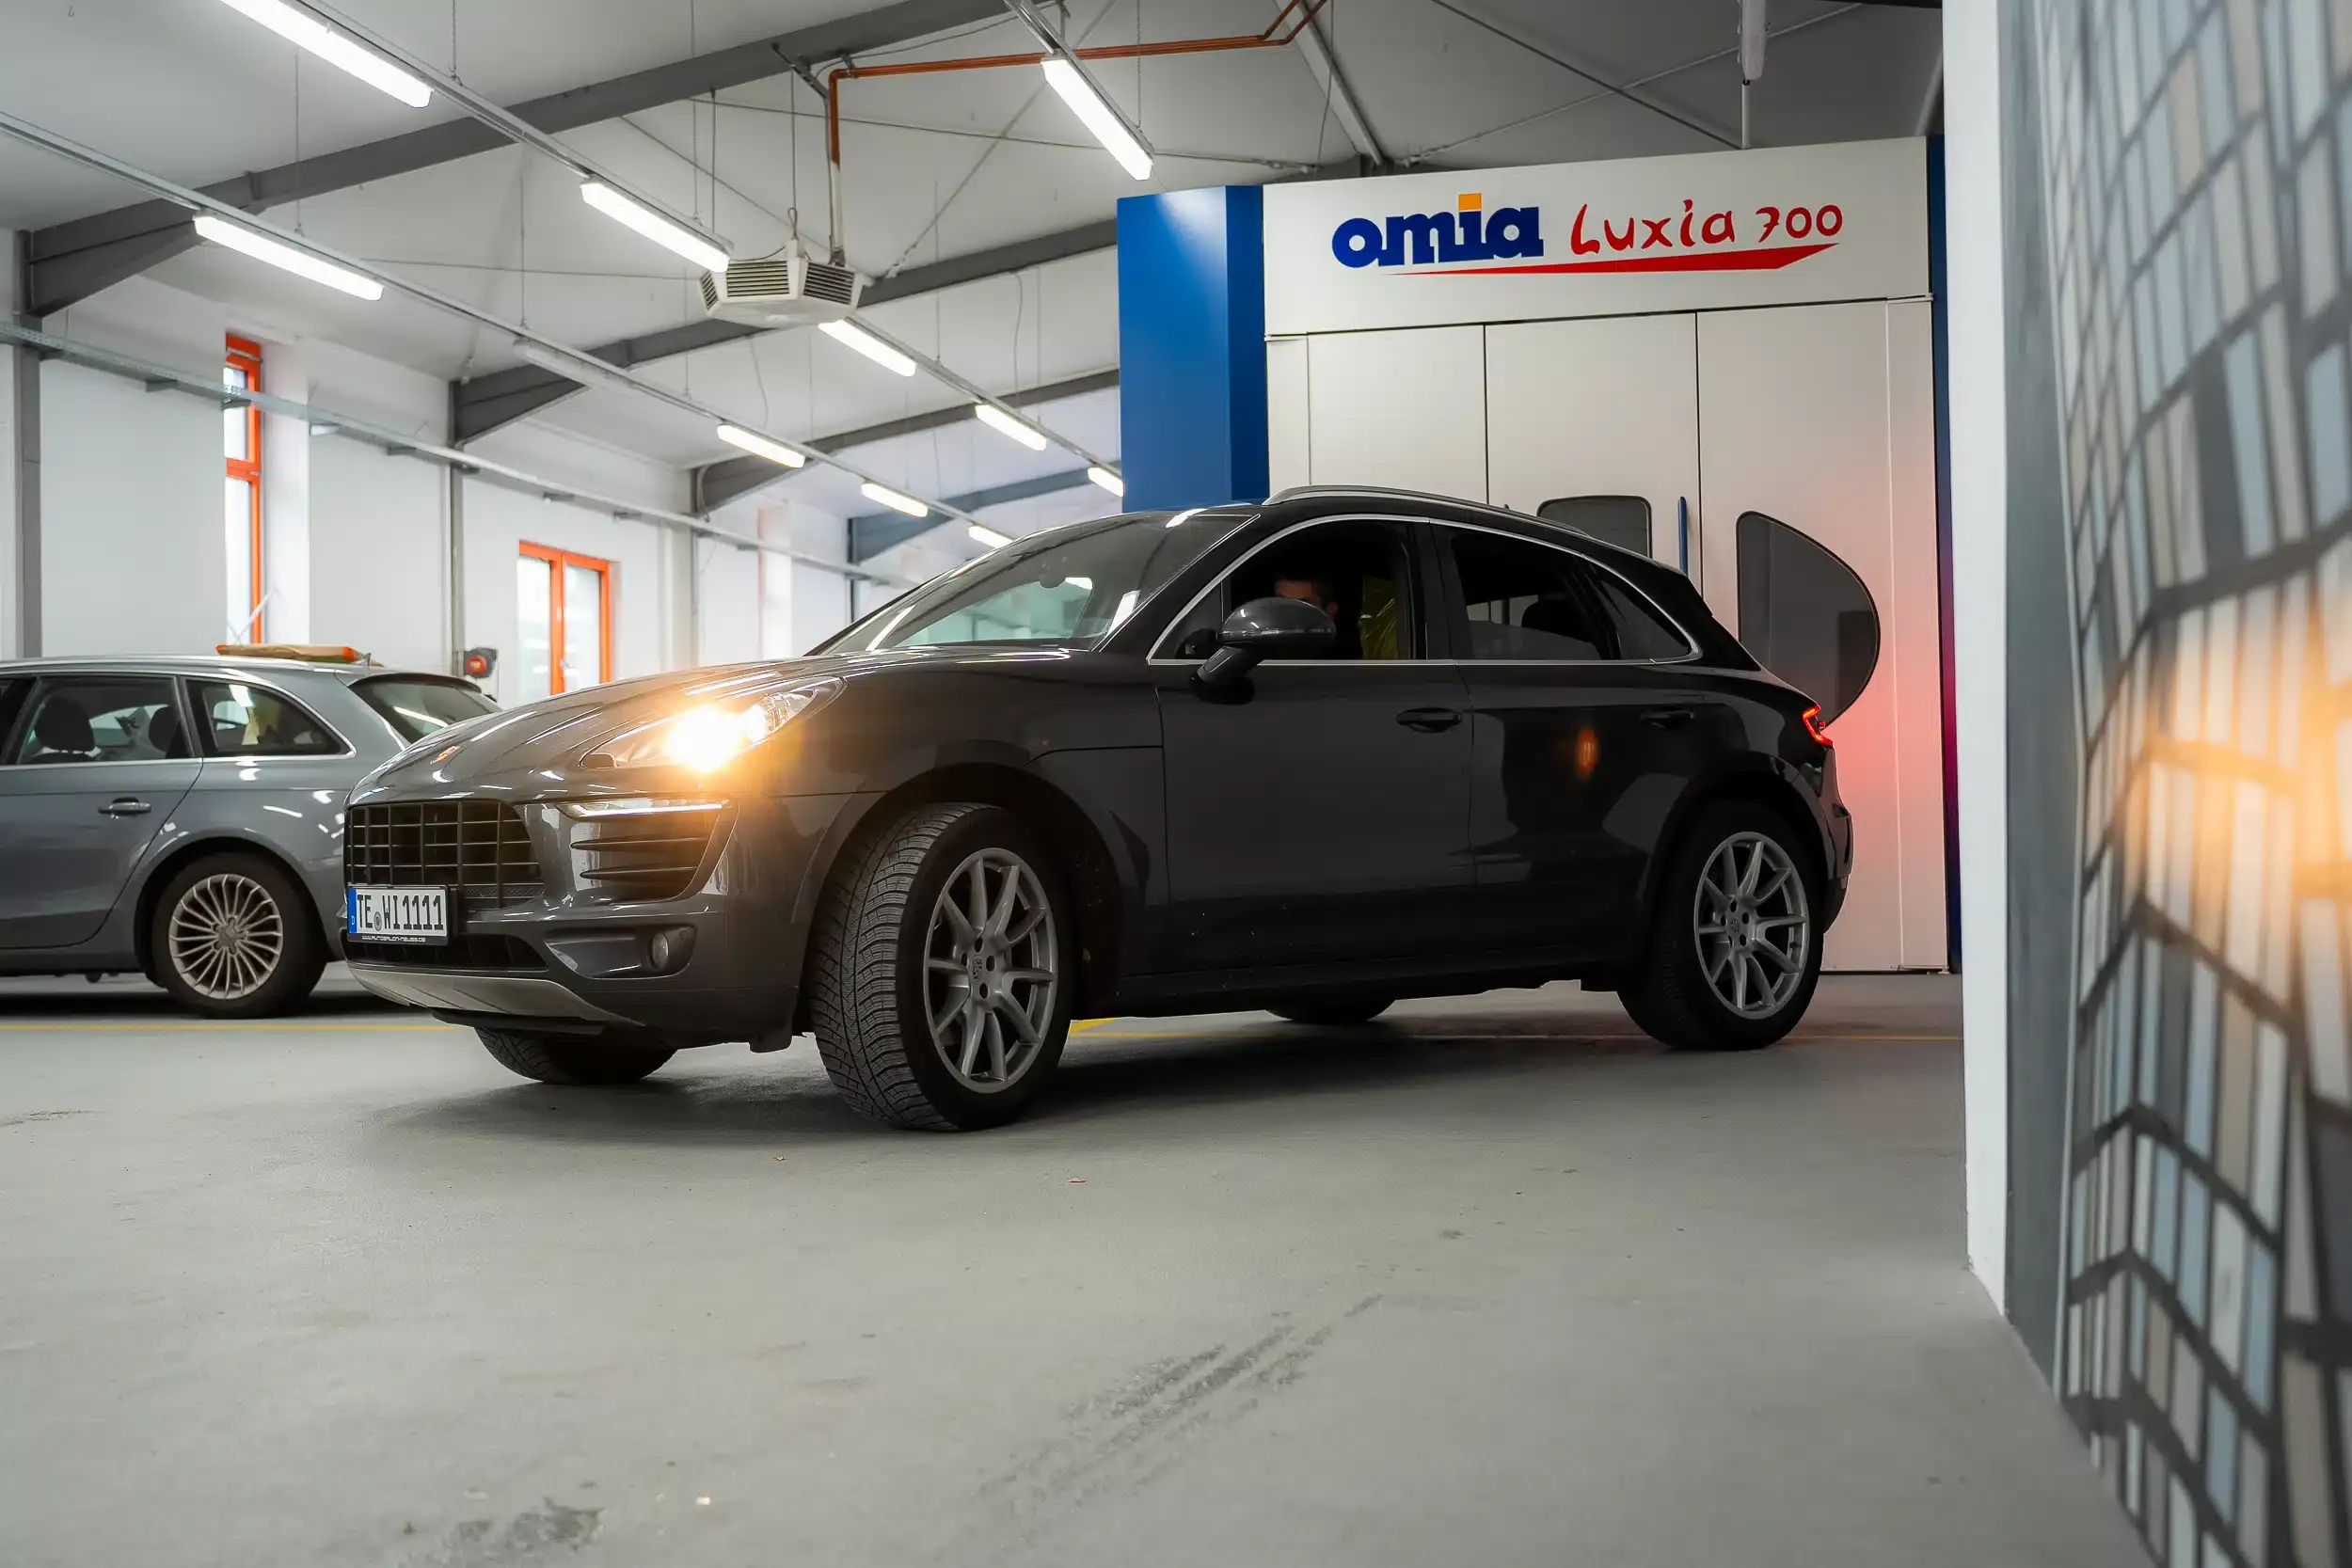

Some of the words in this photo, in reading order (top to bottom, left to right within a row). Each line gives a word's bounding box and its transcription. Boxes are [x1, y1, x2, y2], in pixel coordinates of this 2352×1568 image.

[1332, 193, 1544, 268] omia
[1570, 198, 1735, 256] Luxia
[1756, 204, 1843, 241] 700
